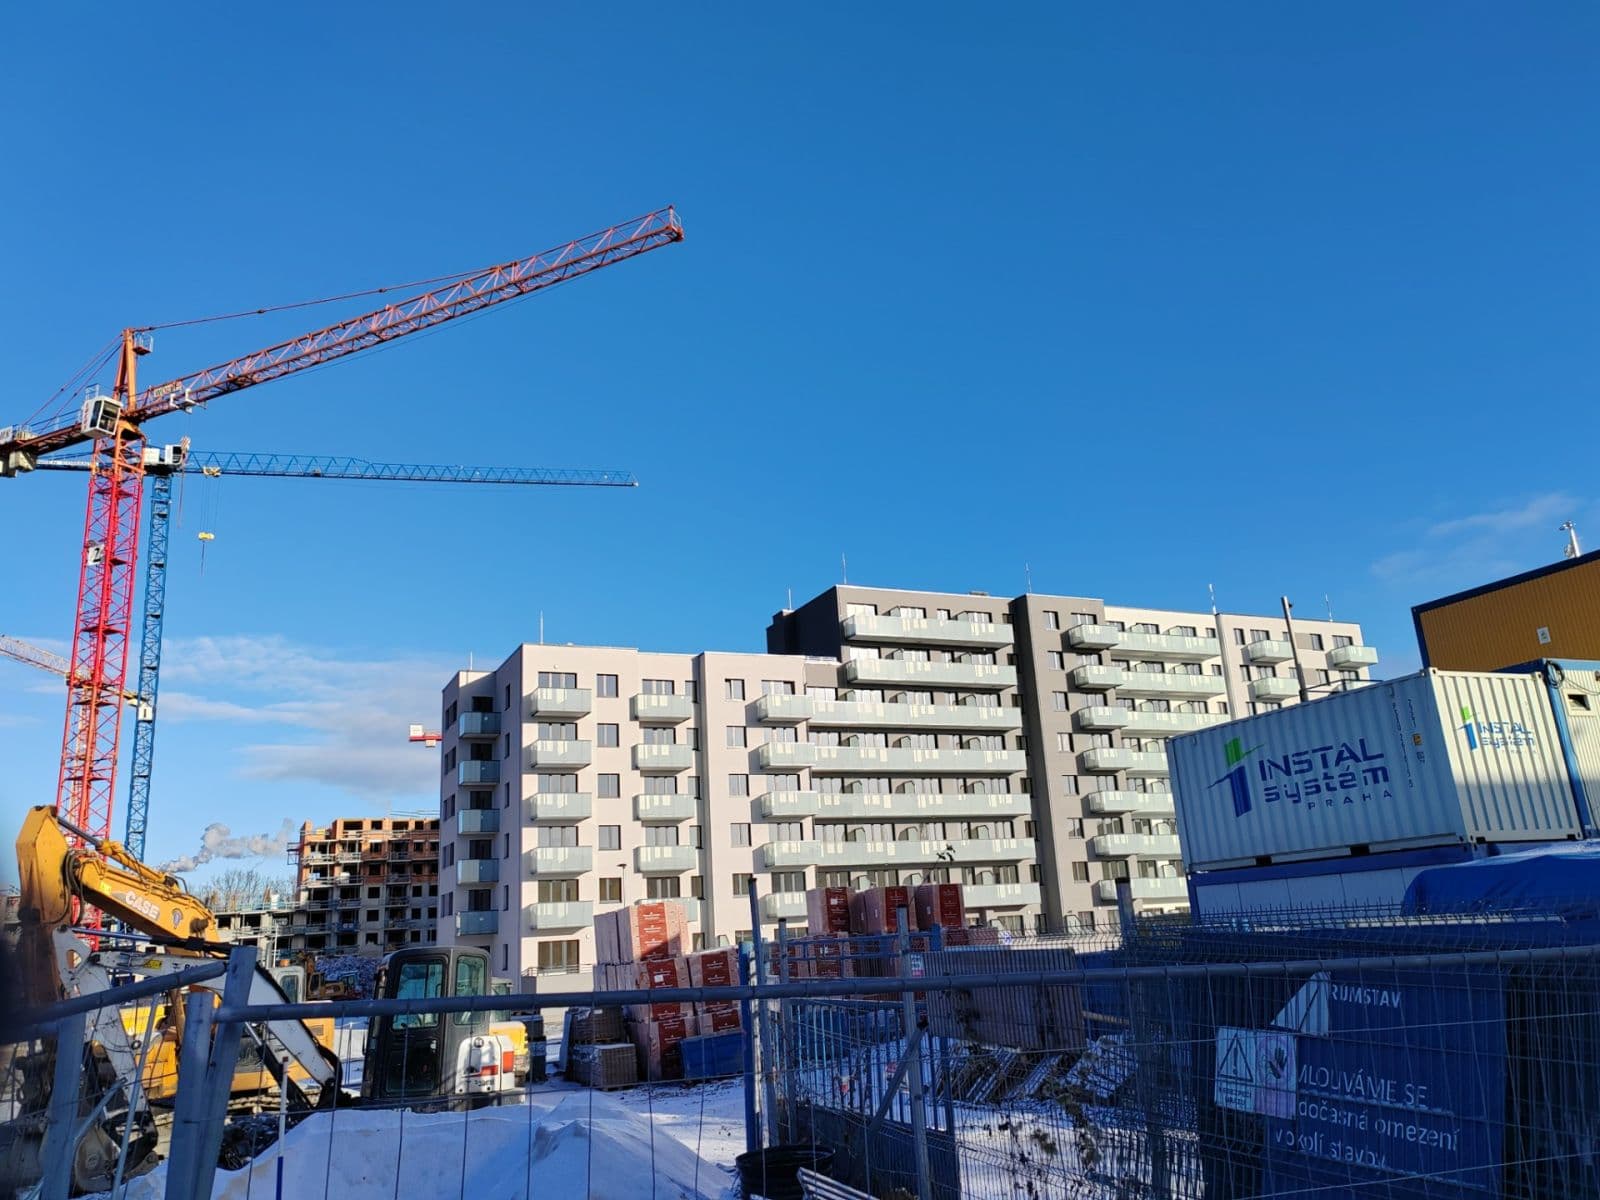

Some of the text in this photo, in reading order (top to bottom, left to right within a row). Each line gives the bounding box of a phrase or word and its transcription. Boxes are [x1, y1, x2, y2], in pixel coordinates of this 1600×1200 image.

[1476, 721, 1533, 735] INSTAL
[1258, 738, 1385, 782] INSTAL
[1307, 789, 1393, 811] PRAHA
[125, 890, 161, 921] CASE
[1404, 1082, 1428, 1108] SE
[1374, 1118, 1461, 1152] omezení
